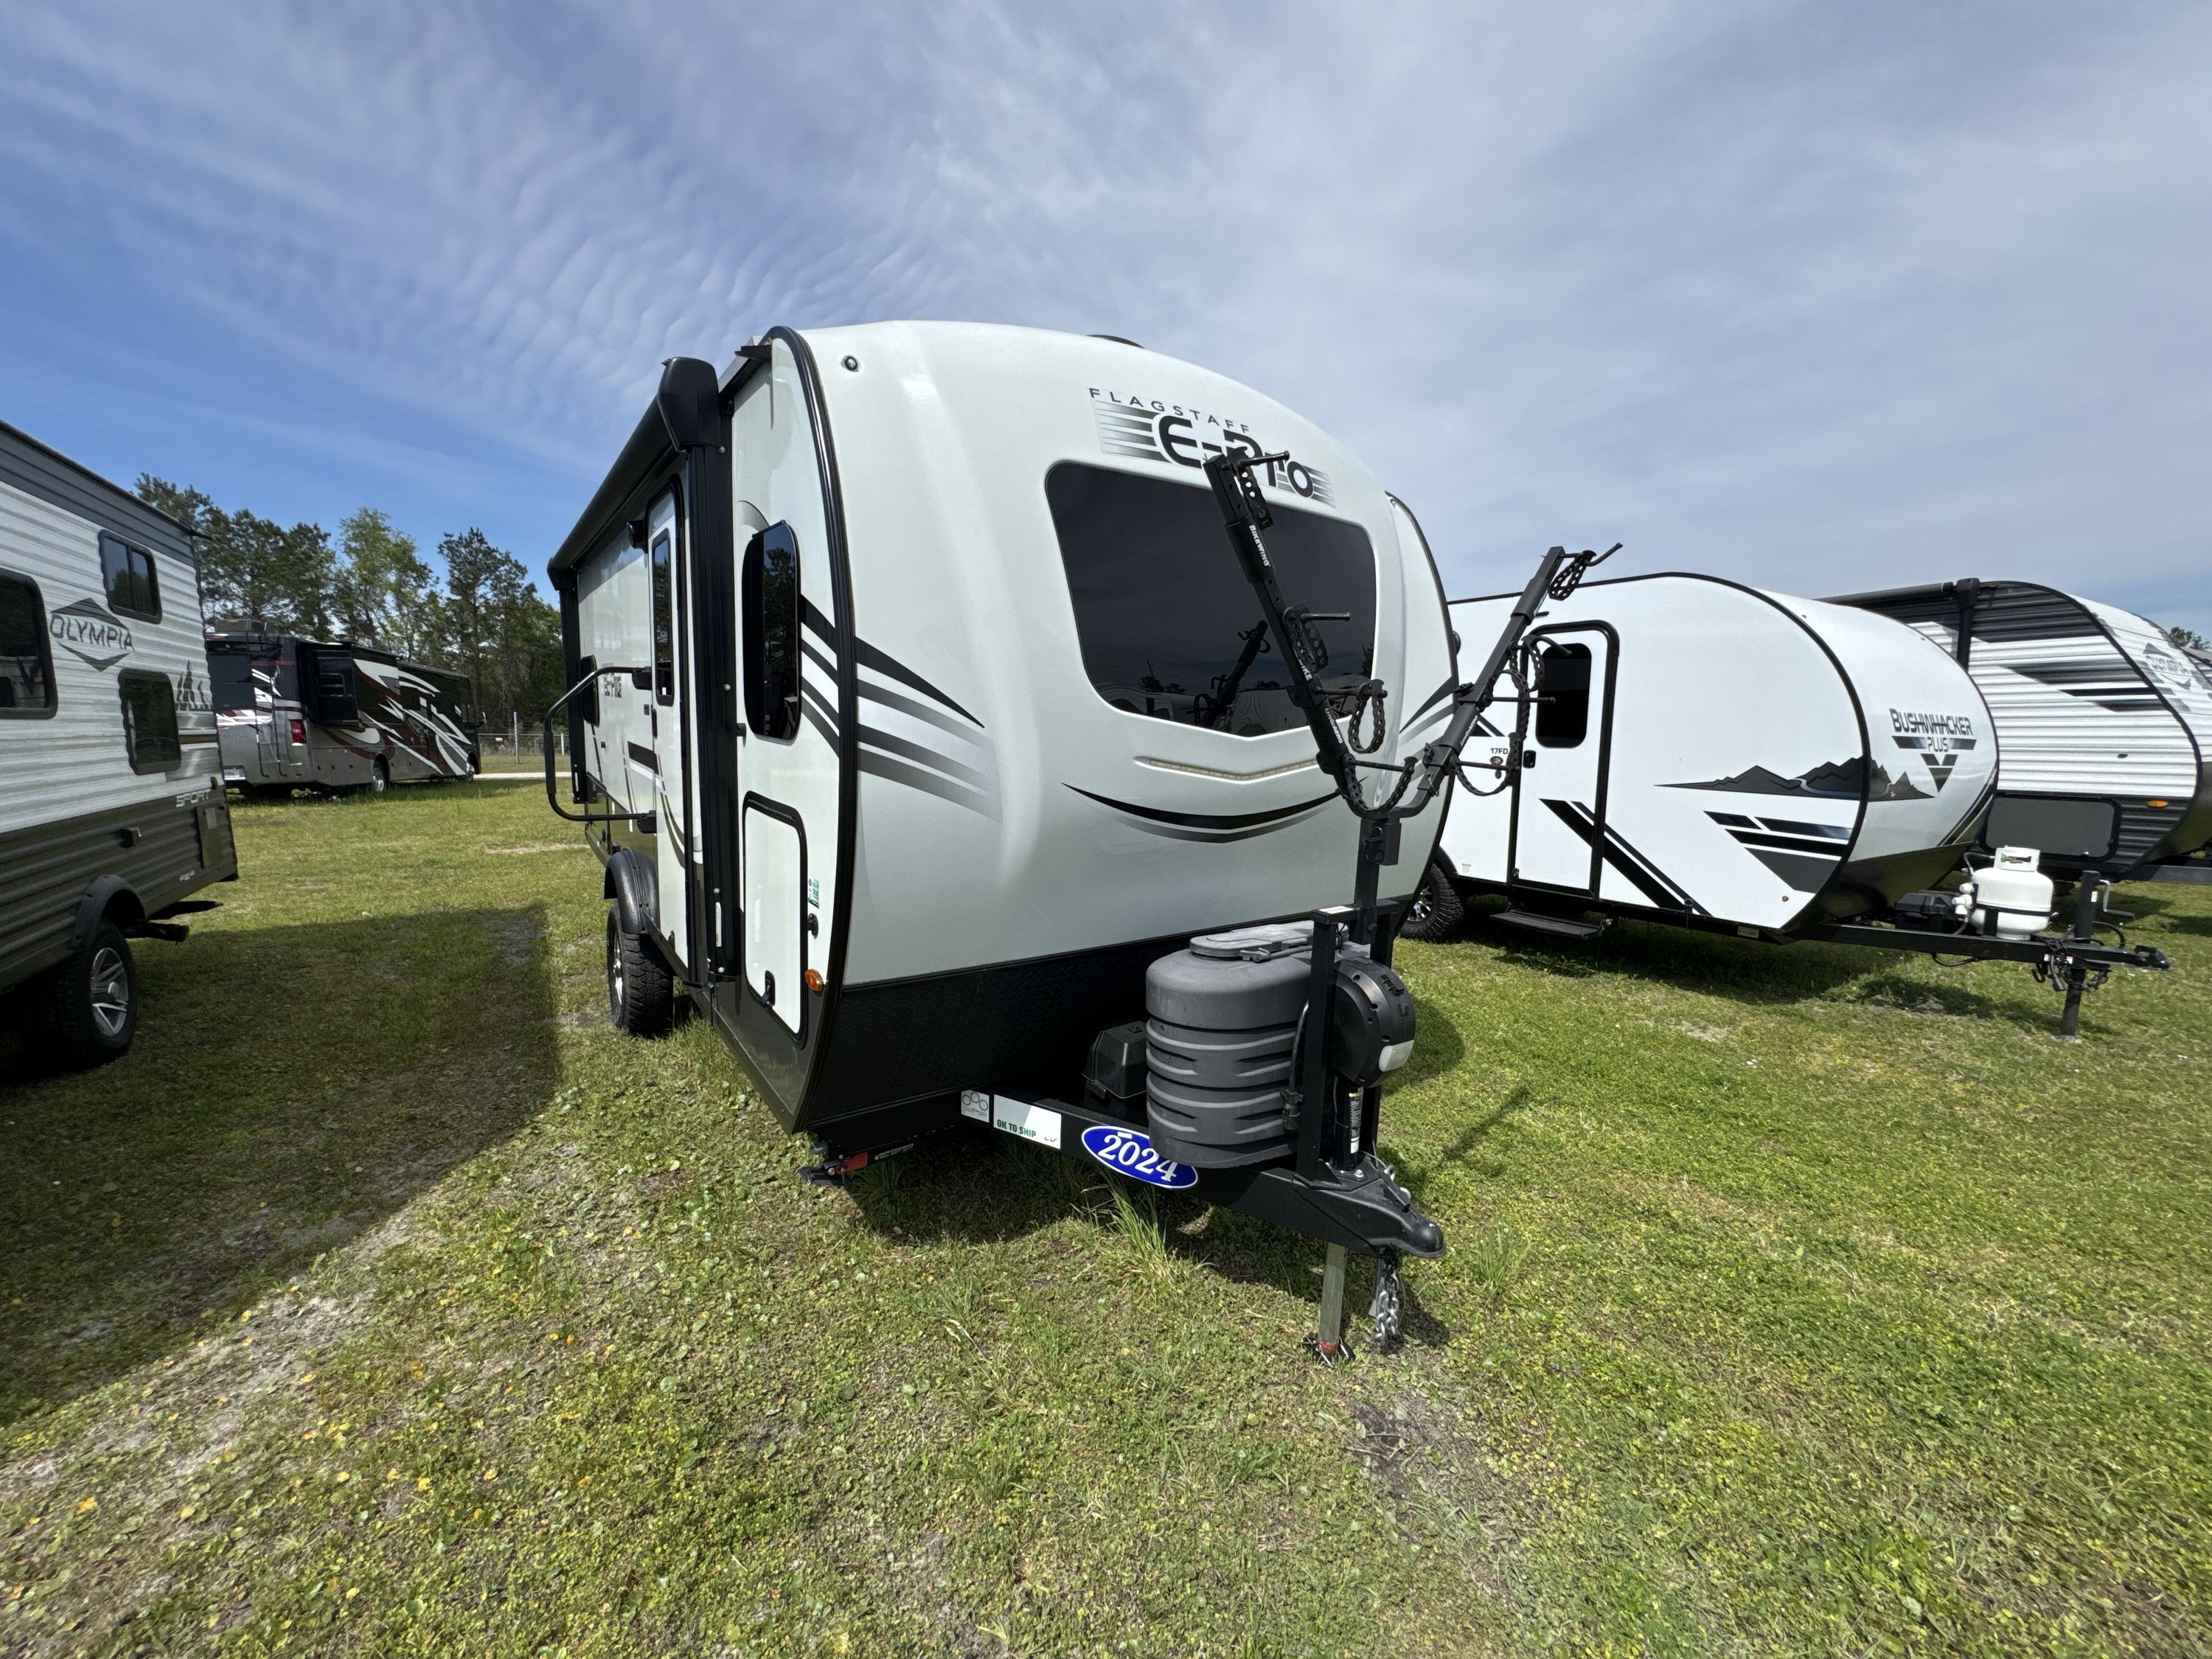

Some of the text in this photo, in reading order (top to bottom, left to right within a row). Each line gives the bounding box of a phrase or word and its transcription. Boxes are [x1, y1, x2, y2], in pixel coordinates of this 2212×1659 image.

[1089, 388, 1249, 434] FLAGSTAFF
[1249, 524, 1270, 566] BIKEWING
[49, 613, 135, 651] OLYMPIA
[1888, 708, 1974, 736] BUSHWHACKER
[1927, 737, 1949, 752] PLUS
[175, 788, 212, 808] SPORT
[997, 1119, 1036, 1138] OK TO SHIP
[1097, 1134, 1178, 1182] 2024
